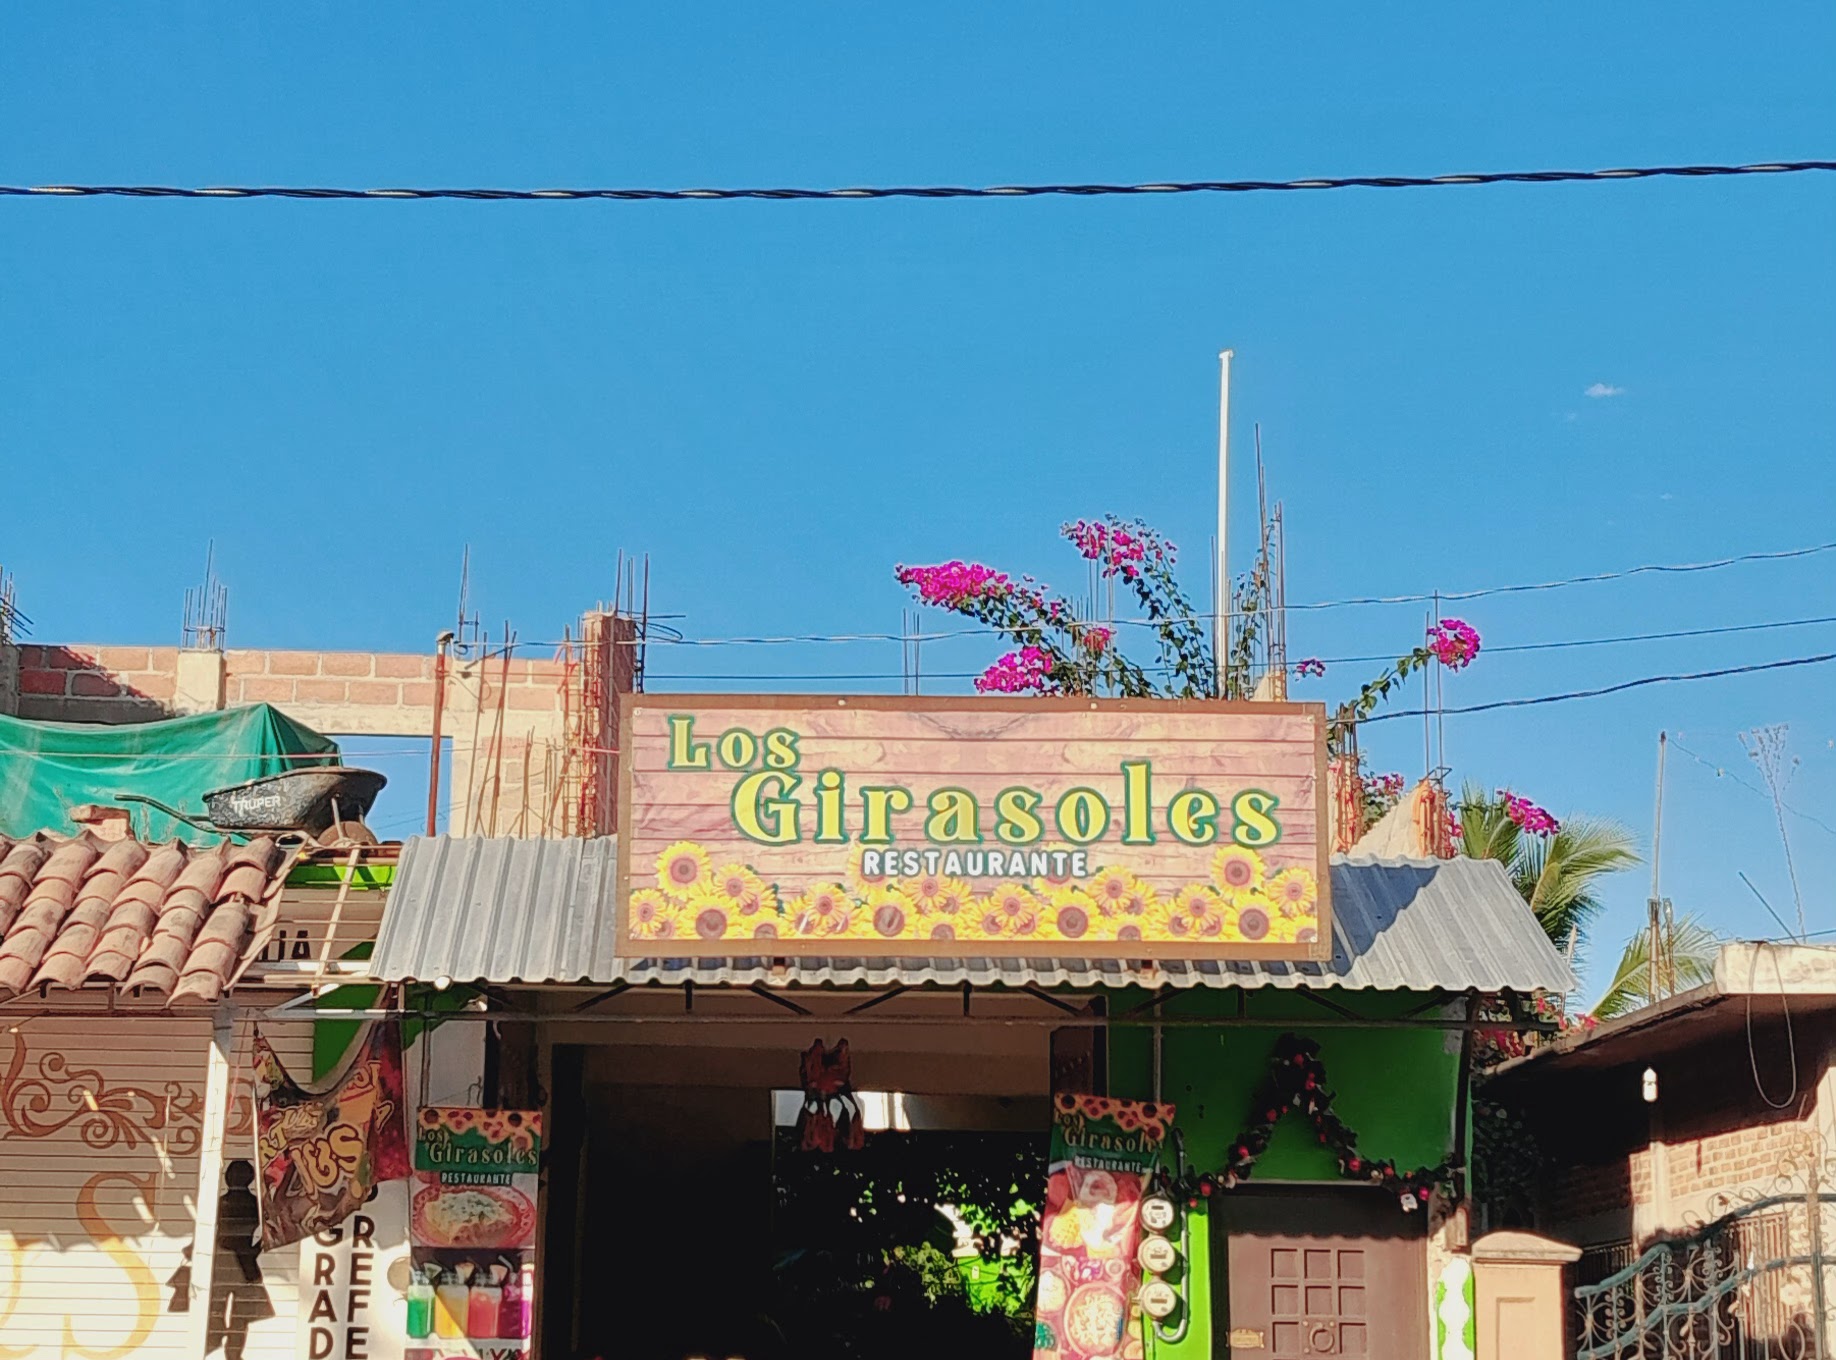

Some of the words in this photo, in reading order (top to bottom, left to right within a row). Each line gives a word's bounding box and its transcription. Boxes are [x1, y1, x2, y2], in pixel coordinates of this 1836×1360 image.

[668, 714, 801, 771] Los
[231, 795, 281, 817] TRUPER
[730, 760, 1282, 846] Girasoles
[862, 849, 1088, 878] RESTAURANTE
[418, 1127, 446, 1141] Los
[429, 1141, 538, 1165] Girasoles
[1074, 1156, 1143, 1173] RESTAURANTE
[441, 1172, 511, 1185] RESTAURANTE
